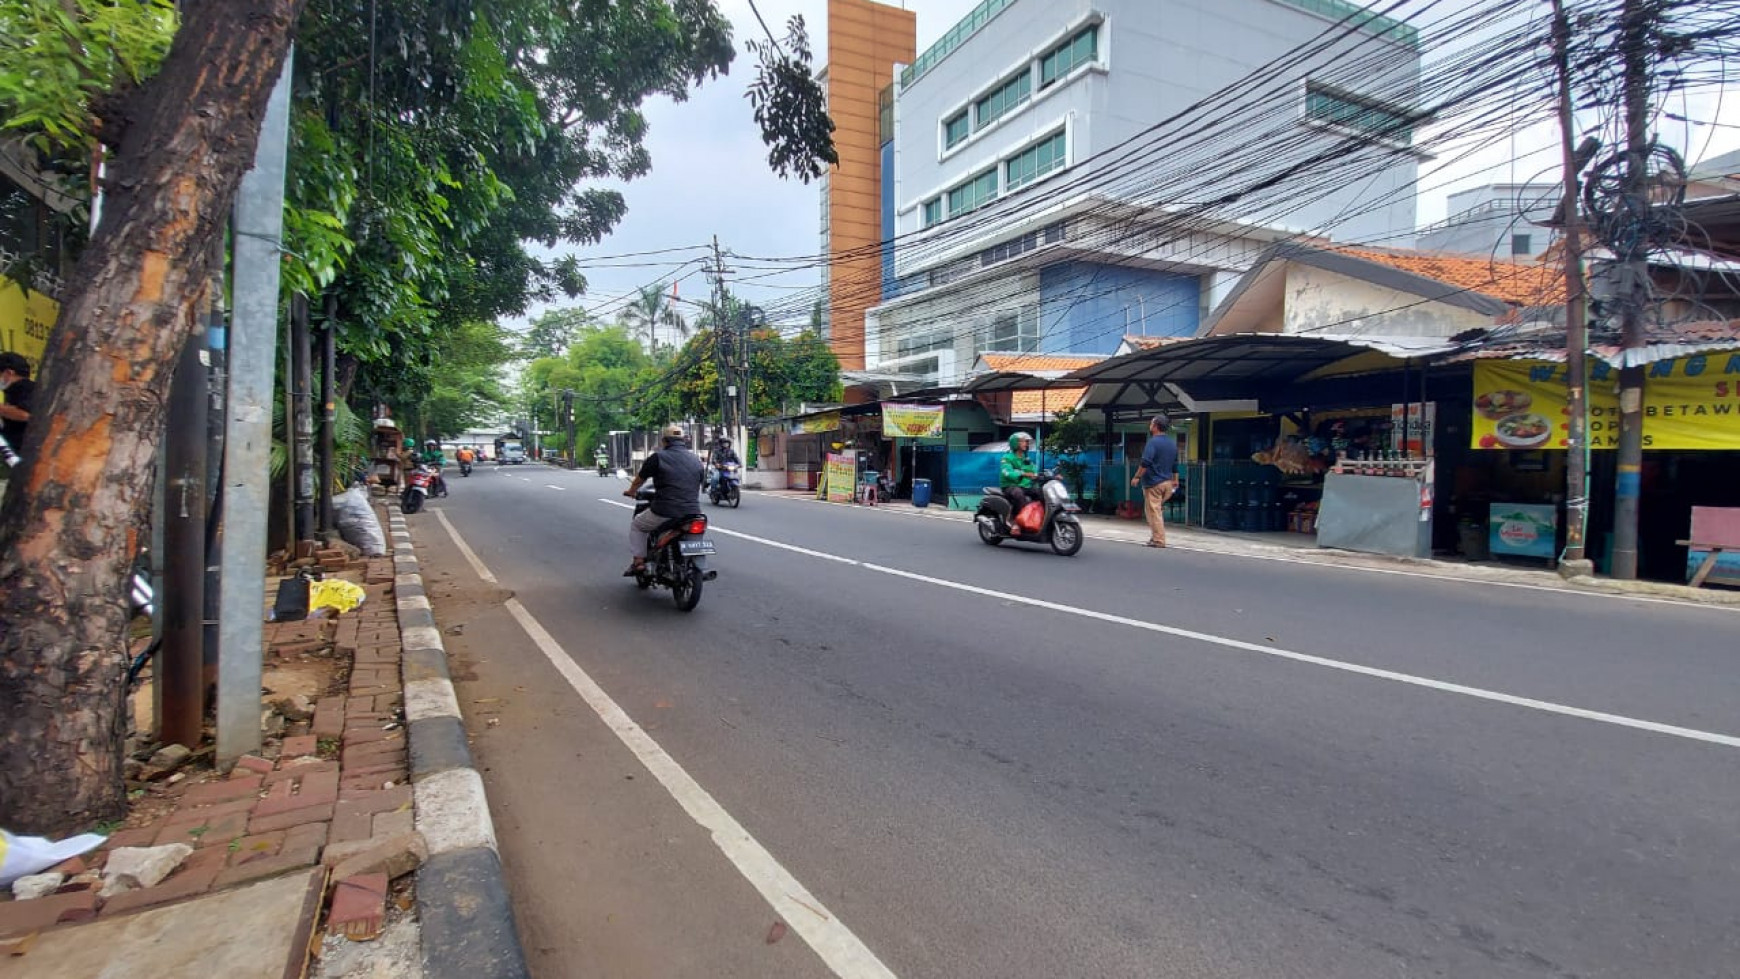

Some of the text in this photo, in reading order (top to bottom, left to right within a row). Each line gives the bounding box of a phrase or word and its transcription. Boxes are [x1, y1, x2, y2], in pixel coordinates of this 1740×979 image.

[1530, 355, 1707, 383] WRNG
[1591, 421, 1619, 432] OP
[1591, 434, 1654, 446] AMS
